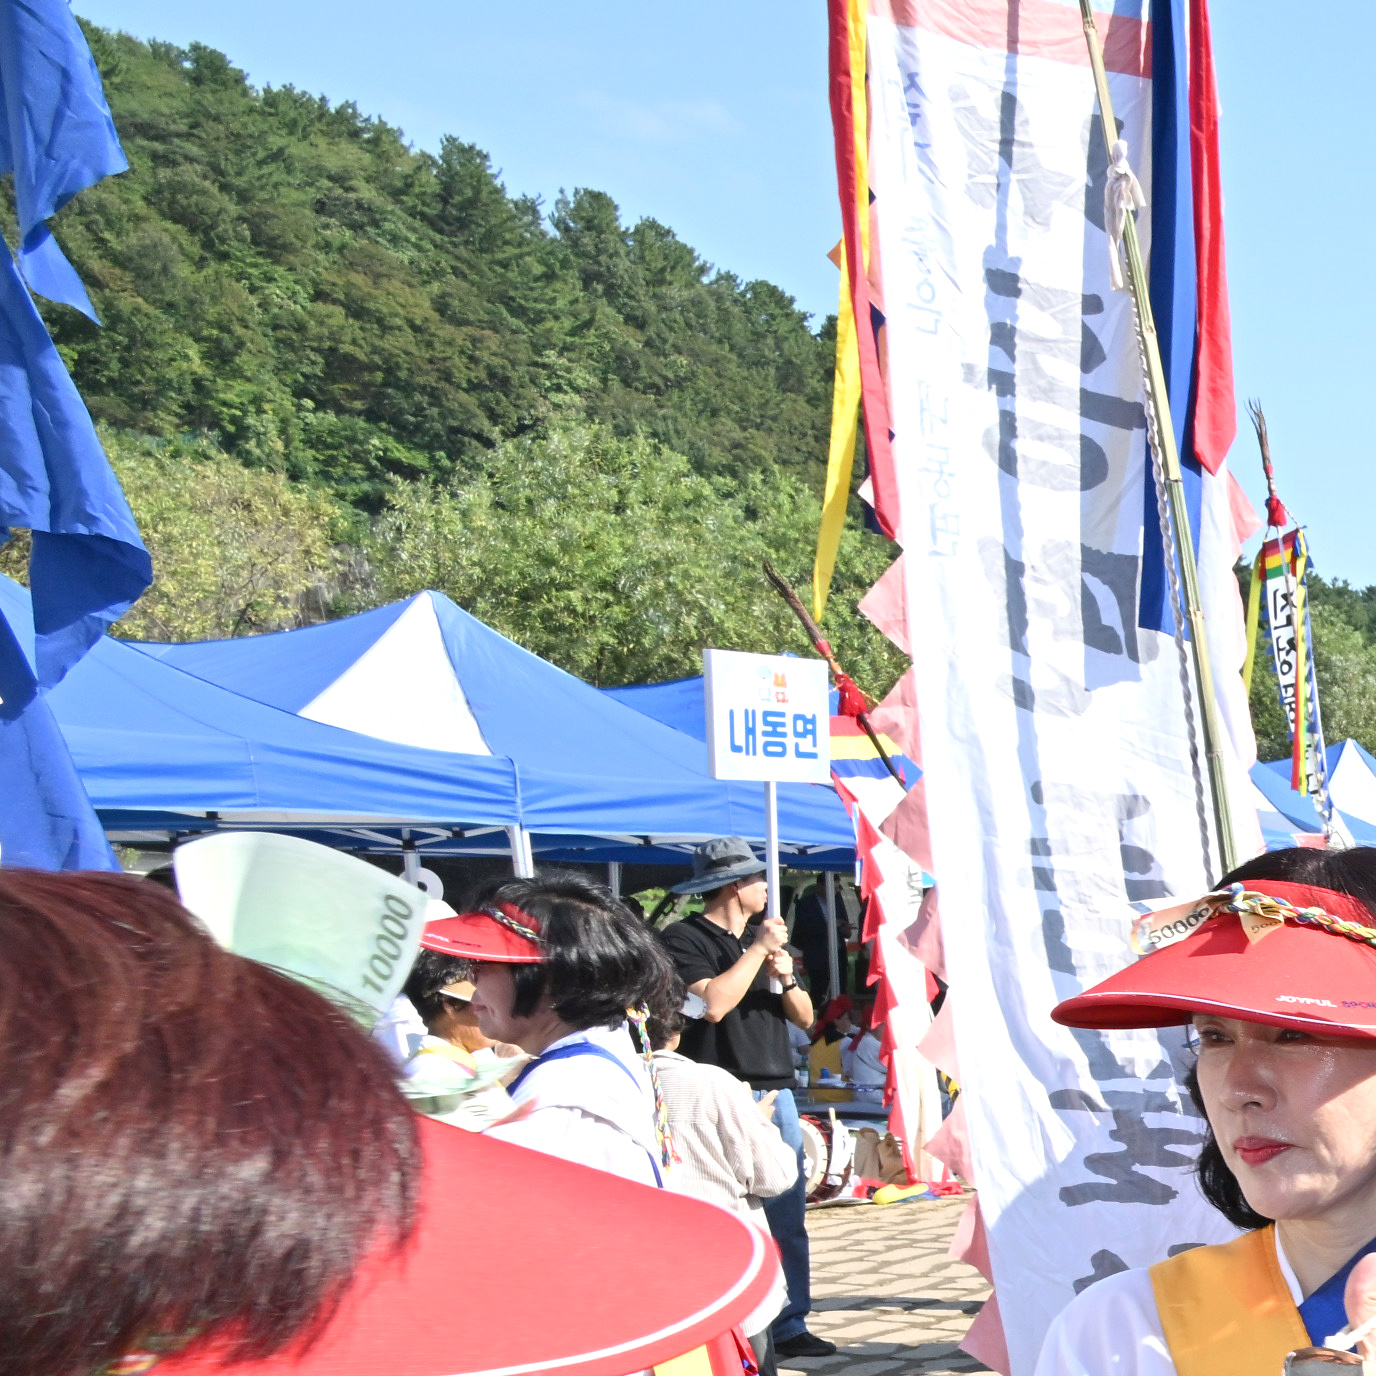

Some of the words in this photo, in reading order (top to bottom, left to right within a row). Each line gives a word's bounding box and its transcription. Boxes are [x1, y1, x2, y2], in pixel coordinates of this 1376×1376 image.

[728, 708, 819, 760] 내동면
[362, 894, 413, 994] 10000
[1276, 994, 1338, 1008] JOYFUL
